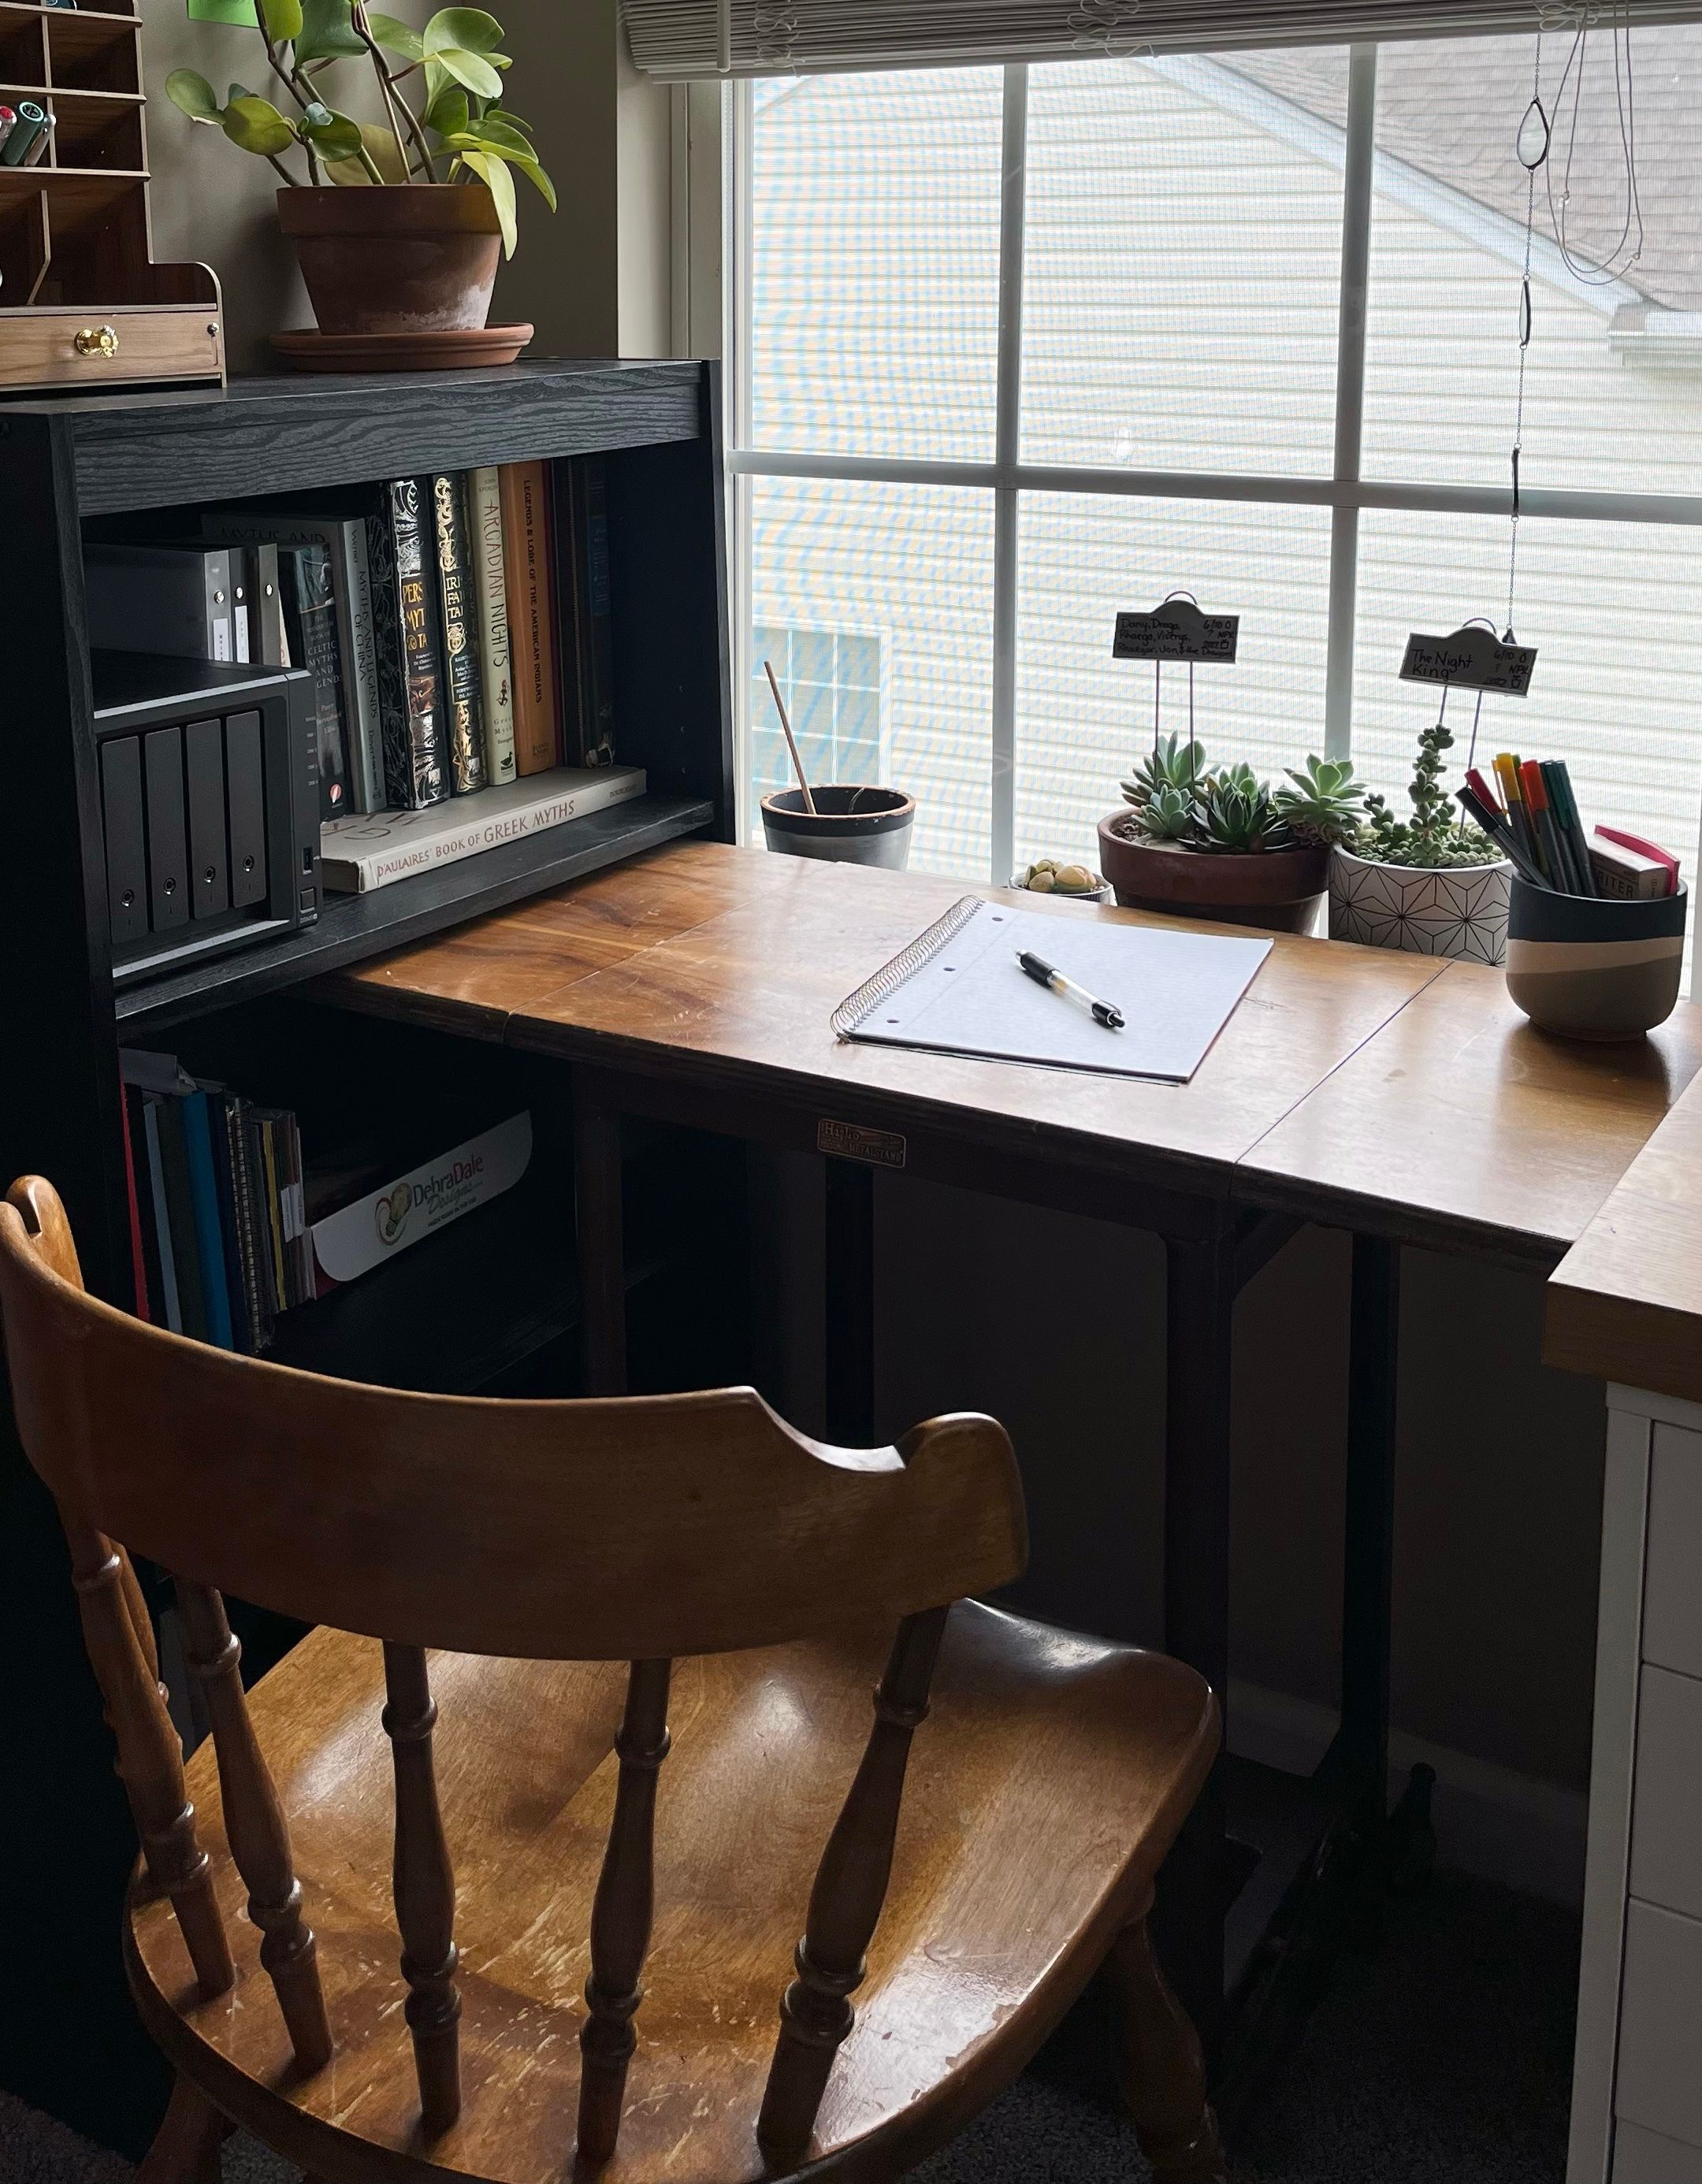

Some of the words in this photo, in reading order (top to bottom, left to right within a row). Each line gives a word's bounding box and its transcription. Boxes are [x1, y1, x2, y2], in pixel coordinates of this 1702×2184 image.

[523, 480, 533, 526] LEGENDS
[484, 498, 504, 598] ARCADIAN
[529, 568, 537, 581] OF
[354, 614, 363, 628] OF
[490, 603, 508, 667] NIGHTS
[530, 609, 541, 660] AMERICAN
[307, 641, 336, 656] CELTIC
[308, 652, 339, 667] MYTHS
[355, 634, 367, 682] CHINA
[363, 626, 374, 659] AND
[315, 665, 334, 678] AND
[1410, 649, 1433, 663] The
[1434, 651, 1475, 674] Night
[1412, 663, 1449, 682] King
[366, 660, 379, 719] LEGENDS
[533, 663, 542, 703] INDIANS
[436, 838, 466, 858] BOOK
[467, 833, 481, 847] OF
[484, 816, 529, 843] GREEK
[533, 800, 574, 827] MYTHS
